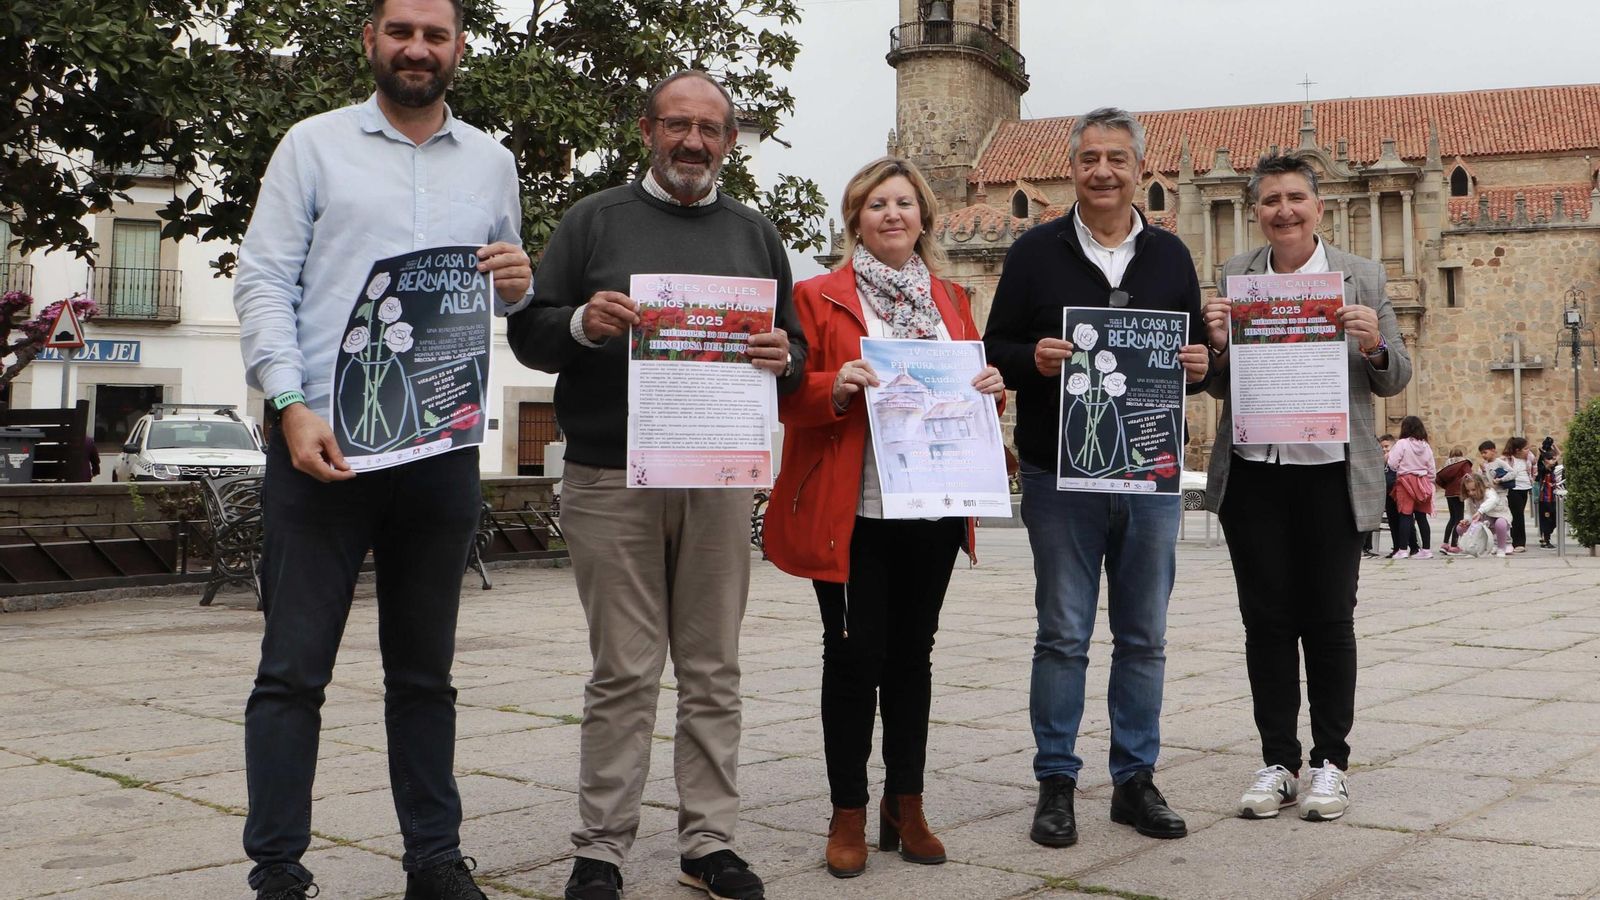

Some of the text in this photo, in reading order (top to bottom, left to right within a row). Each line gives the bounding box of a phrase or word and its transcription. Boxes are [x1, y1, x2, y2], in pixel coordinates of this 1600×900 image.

[417, 255, 431, 269] LA
[434, 253, 464, 269] CASA
[468, 253, 479, 269] D
[396, 269, 486, 293] BERNARDA
[440, 292, 487, 314] ALBA
[1280, 293, 1337, 302] FACHADAS
[637, 299, 768, 313] PATIOS Y FACHADAS
[1271, 305, 1301, 315] 2025
[686, 315, 723, 326] 2025
[1123, 317, 1138, 329] LA
[1141, 318, 1168, 331] CASA
[1170, 319, 1184, 332] DE
[1244, 325, 1336, 337] HINOJOSA DEL DUQUE
[649, 340, 702, 352] HINOJOSA
[703, 341, 723, 352] DEL
[1108, 329, 1182, 351] BERNARDA
[43, 343, 138, 361] MDA JEI
[891, 361, 936, 371] PINTURA
[1147, 350, 1181, 370] ALBA
[441, 375, 455, 384] 2025
